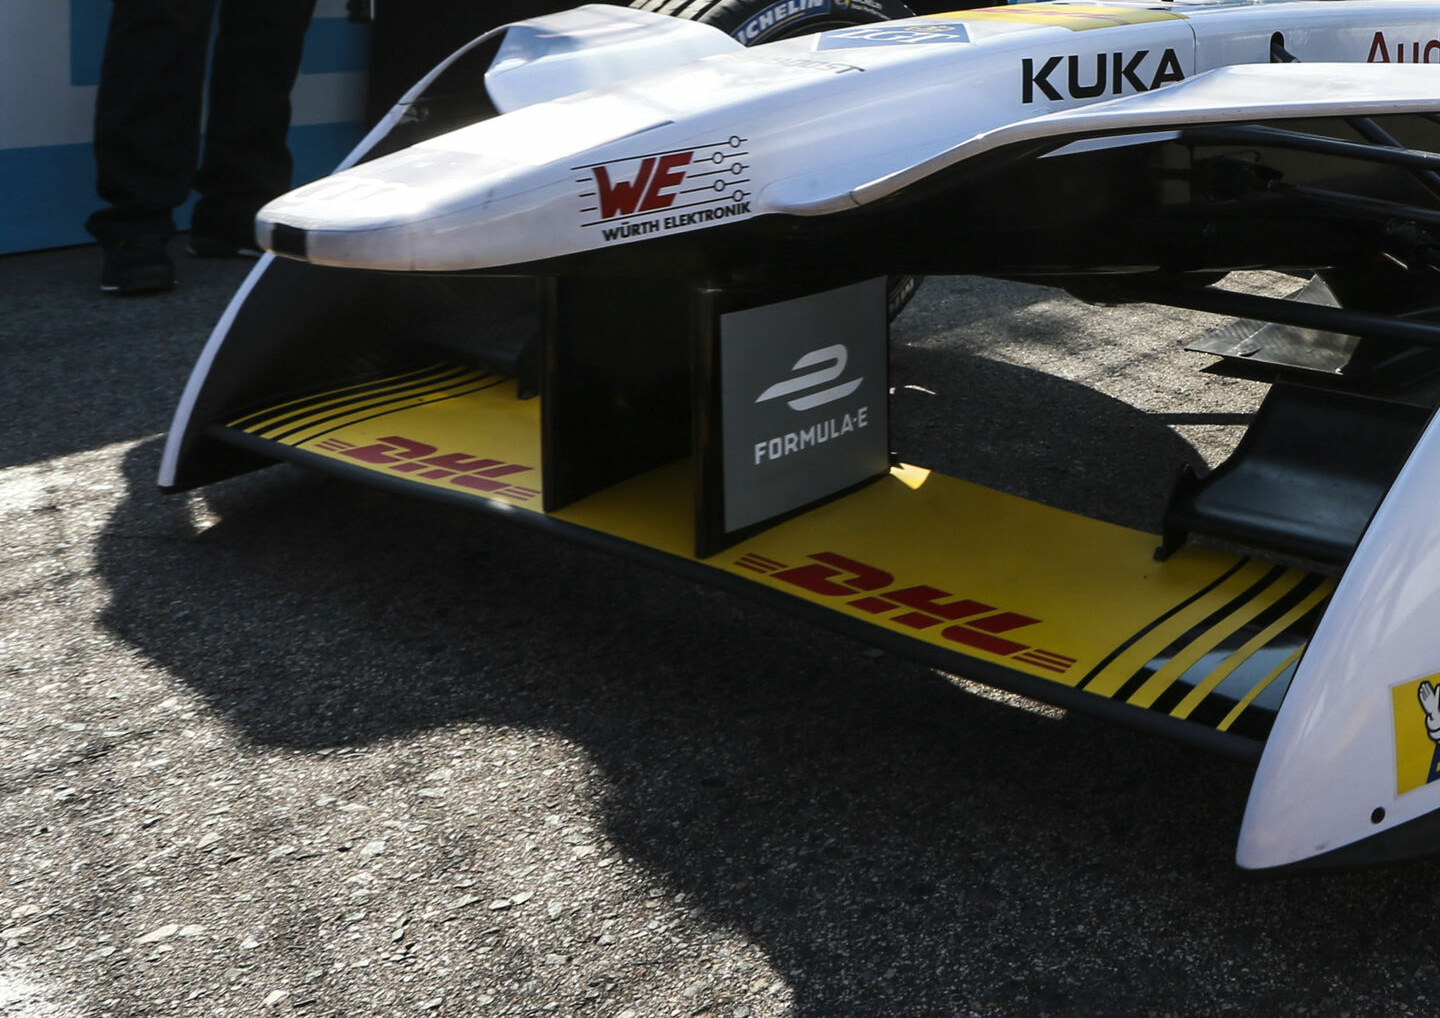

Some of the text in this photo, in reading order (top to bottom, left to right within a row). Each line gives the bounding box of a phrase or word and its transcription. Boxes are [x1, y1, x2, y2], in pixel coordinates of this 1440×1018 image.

[1022, 49, 1185, 104] KUKA
[592, 151, 695, 219] WE
[602, 201, 752, 242] WÜRTH ELEKTRONIK
[338, 436, 535, 492] DHL
[768, 552, 1044, 656] DHL
